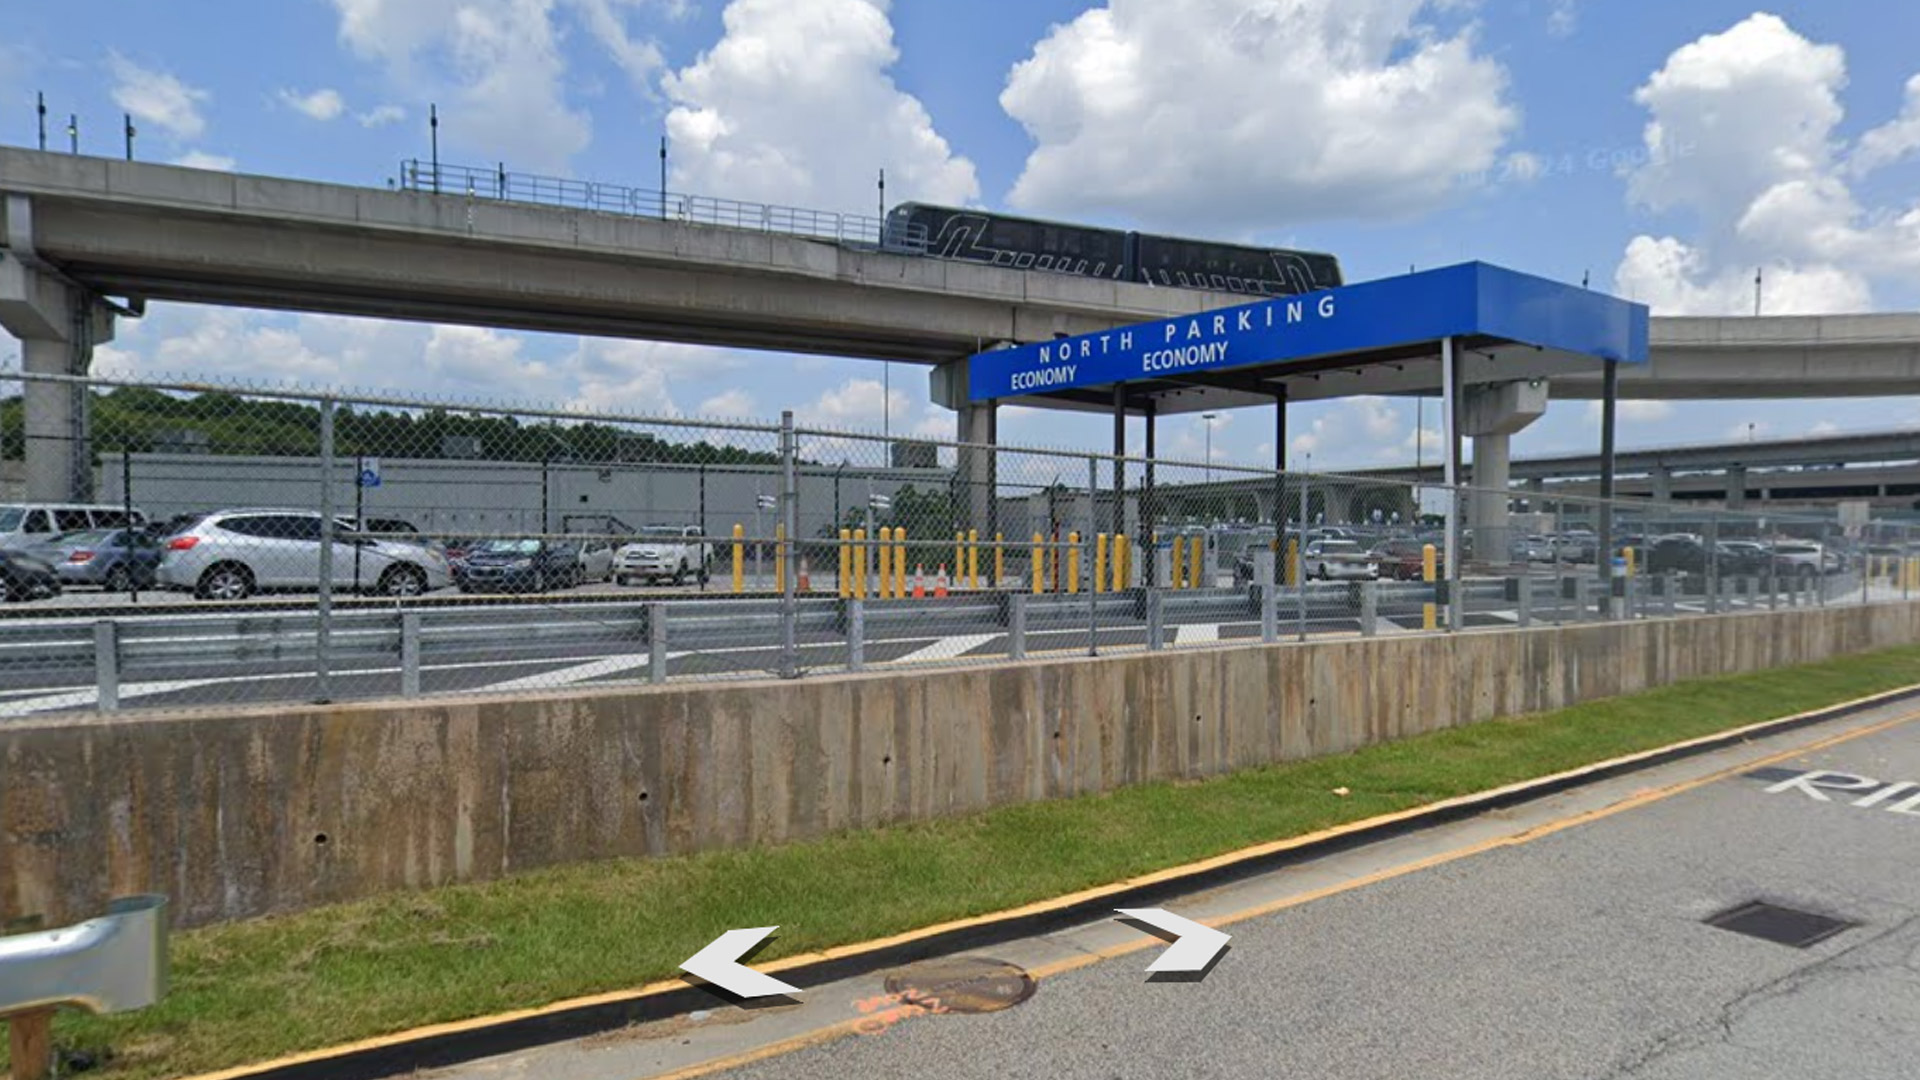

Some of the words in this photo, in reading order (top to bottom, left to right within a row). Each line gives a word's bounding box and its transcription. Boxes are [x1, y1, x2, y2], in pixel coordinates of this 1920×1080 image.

[1039, 331, 1133, 364] NORTH
[1165, 295, 1334, 343] PARKING
[1143, 341, 1229, 372] ECONOMY
[1011, 365, 1077, 390] ECONOMY
